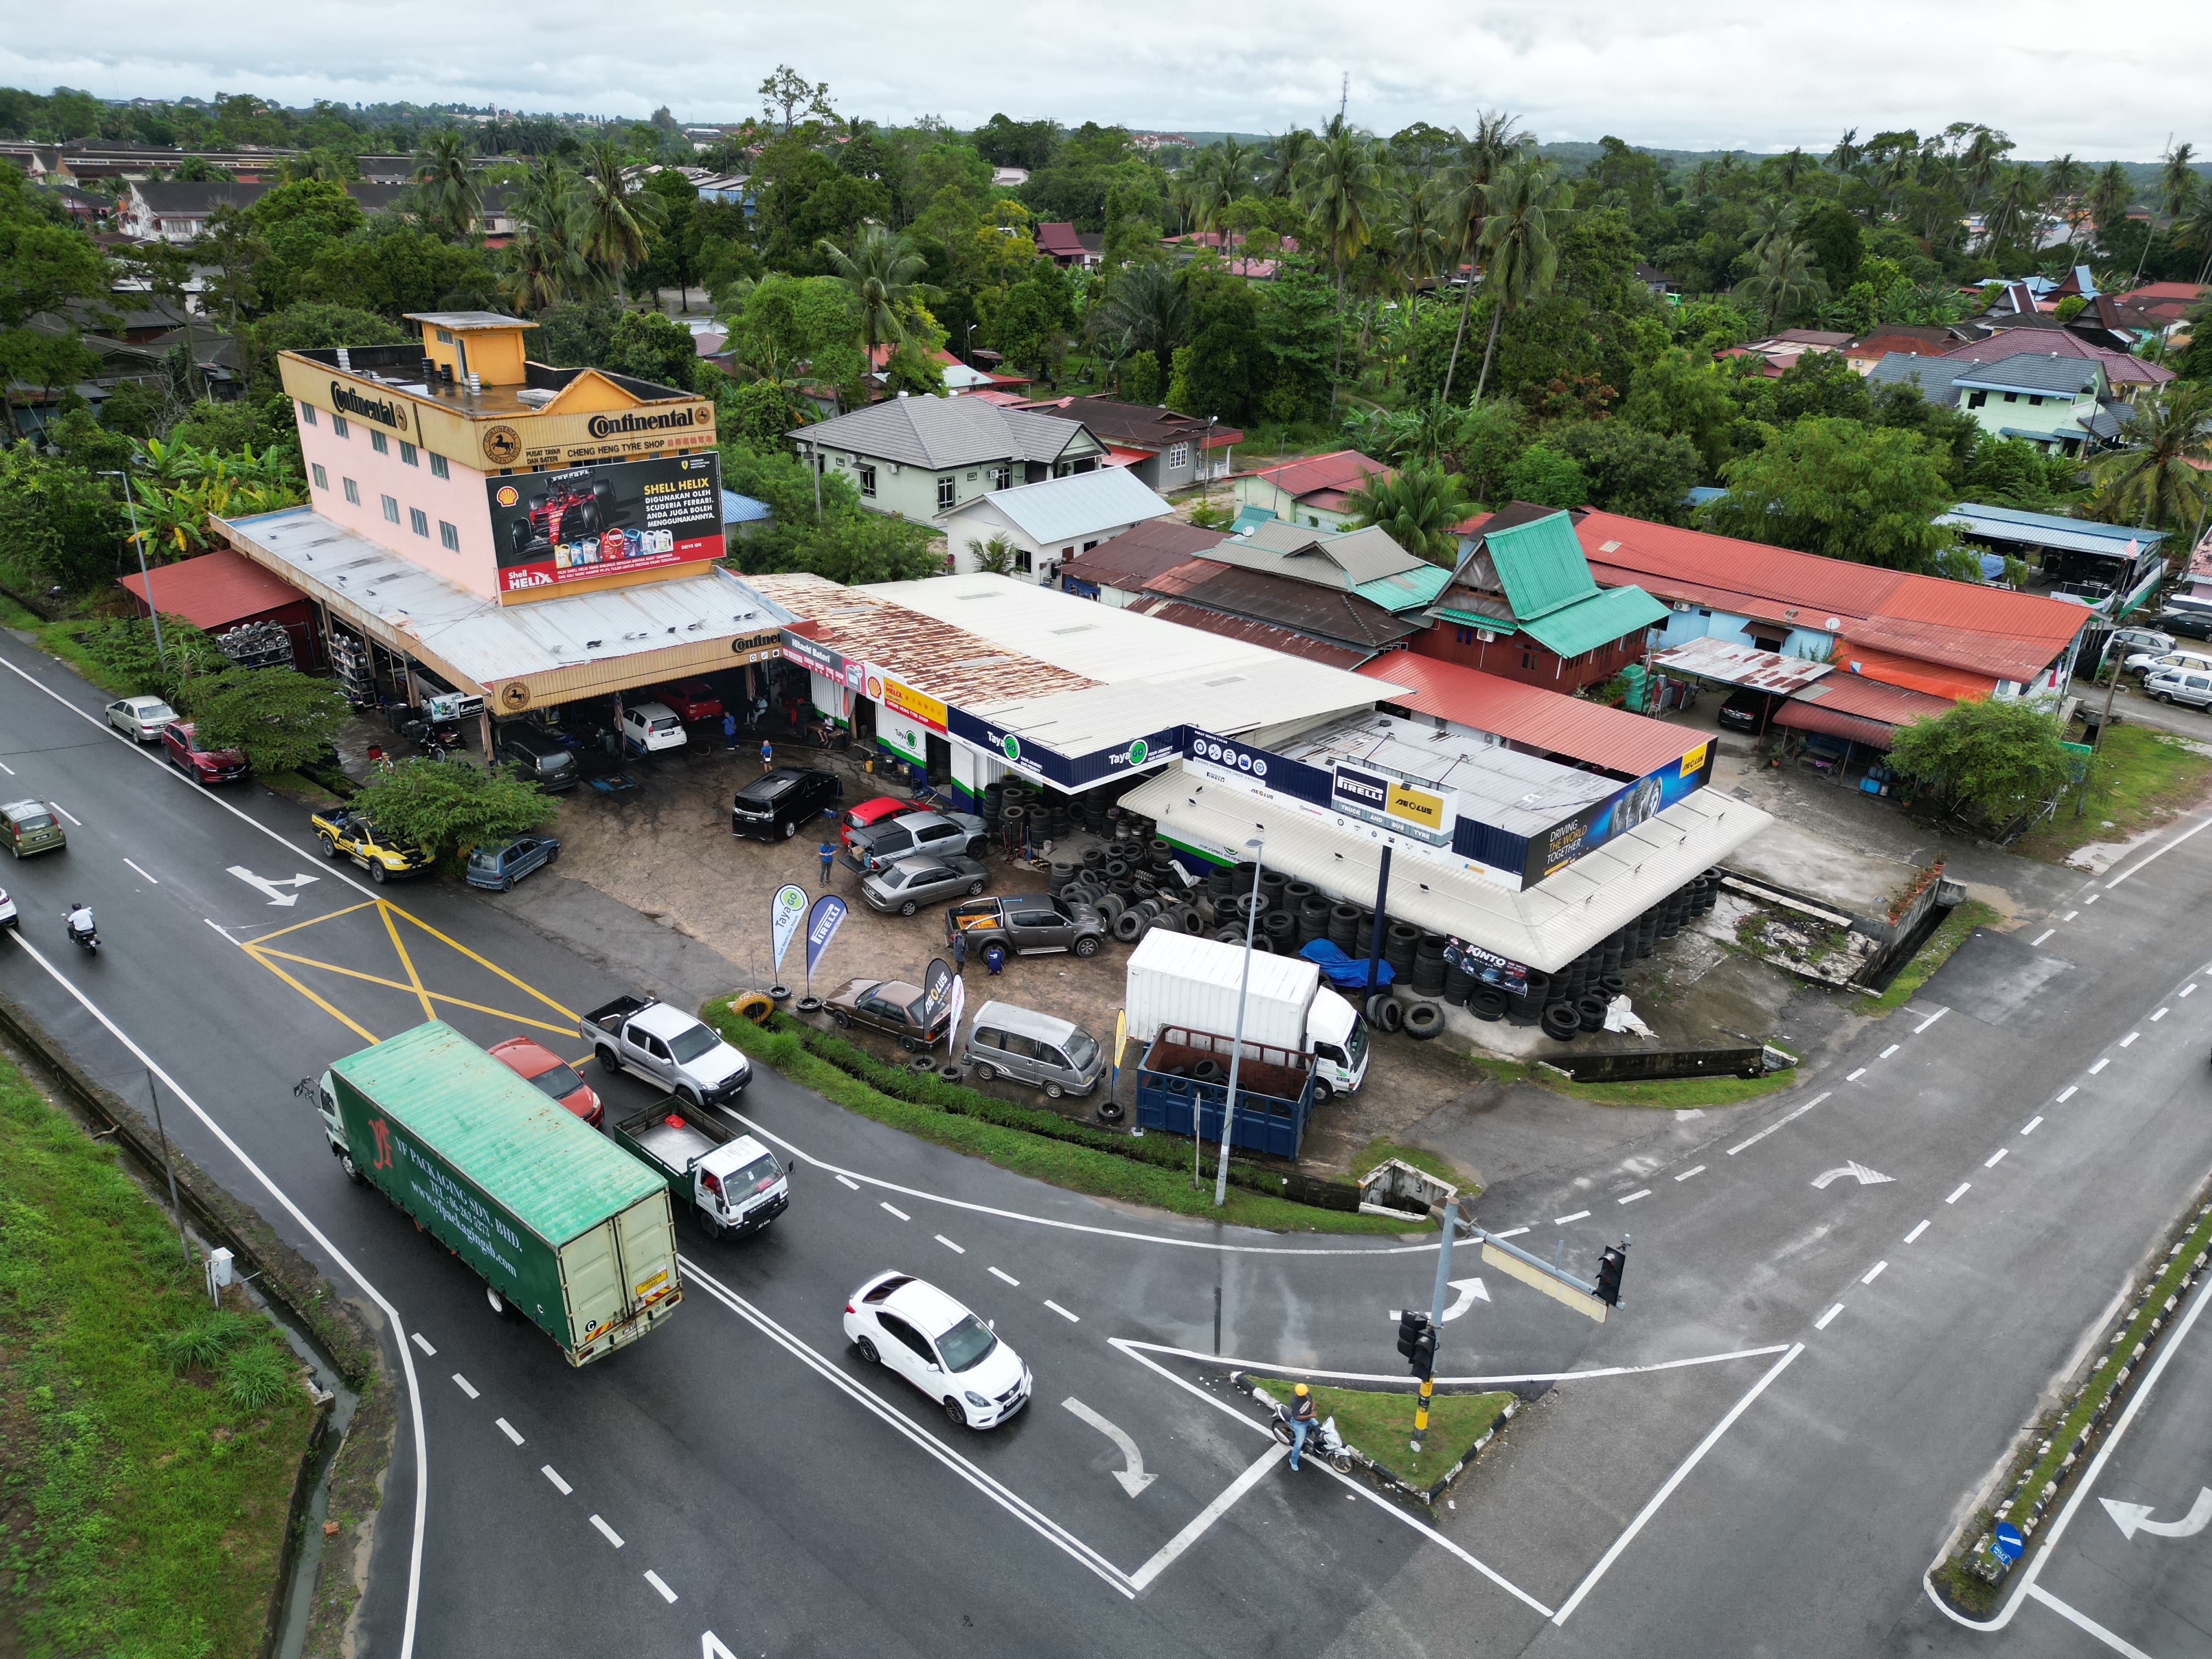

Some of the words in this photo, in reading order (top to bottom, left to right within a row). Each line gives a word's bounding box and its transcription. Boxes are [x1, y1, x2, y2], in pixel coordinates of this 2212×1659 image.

[331, 381, 398, 428] Continental
[588, 408, 695, 438] Continental
[484, 426, 518, 443] CONTINENTAL
[567, 448, 595, 457] CHENG
[598, 445, 619, 454] HENG
[622, 442, 642, 452] TYRE
[644, 440, 665, 449] SHOP
[644, 482, 676, 495] SHELL
[678, 477, 709, 490] HELIX
[645, 492, 690, 504] DIGUNAKAN
[692, 489, 711, 497] OLEH
[646, 501, 681, 512] SCUDERIA
[684, 497, 714, 506] FERRARI.
[647, 511, 668, 520] ANDA
[669, 508, 689, 517] JUGA
[690, 505, 713, 514] BOLEH
[647, 512, 715, 528] MENGGUNAKANNYA.
[508, 569, 527, 579] Shell
[509, 574, 553, 590] HELIX
[792, 638, 812, 654] Hitachi
[812, 648, 830, 663] Bateri
[885, 686, 904, 699] HELIX
[1337, 775, 1384, 802] PIRELLI
[1395, 798, 1433, 815] AEOLUS
[1341, 804, 1362, 816] TRUCK
[1370, 815, 1383, 823] AND
[1392, 822, 1404, 831] BUS
[1414, 830, 1431, 840] TYRE
[1550, 819, 1578, 843] DRIVING
[1549, 842, 1562, 853] THE
[1563, 825, 1587, 846] WORLD
[1547, 838, 1581, 865] TOGETHER
[810, 904, 840, 945] PIRELLI
[1465, 945, 1506, 966] KINTO
[925, 971, 948, 1015] AEOLUS
[394, 1136, 408, 1156] YF
[409, 1148, 467, 1205] PACKAGING
[469, 1197, 494, 1227] SDN.
[495, 1217, 523, 1252] BHD.
[1416, 1182, 1422, 1193] 3
[411, 1181, 517, 1278] www.yfpackagingsb.com
[473, 1216, 490, 1238] 5273
[1993, 1550, 2005, 1562] KIRI
[1994, 1545, 2008, 1561] IKUT
